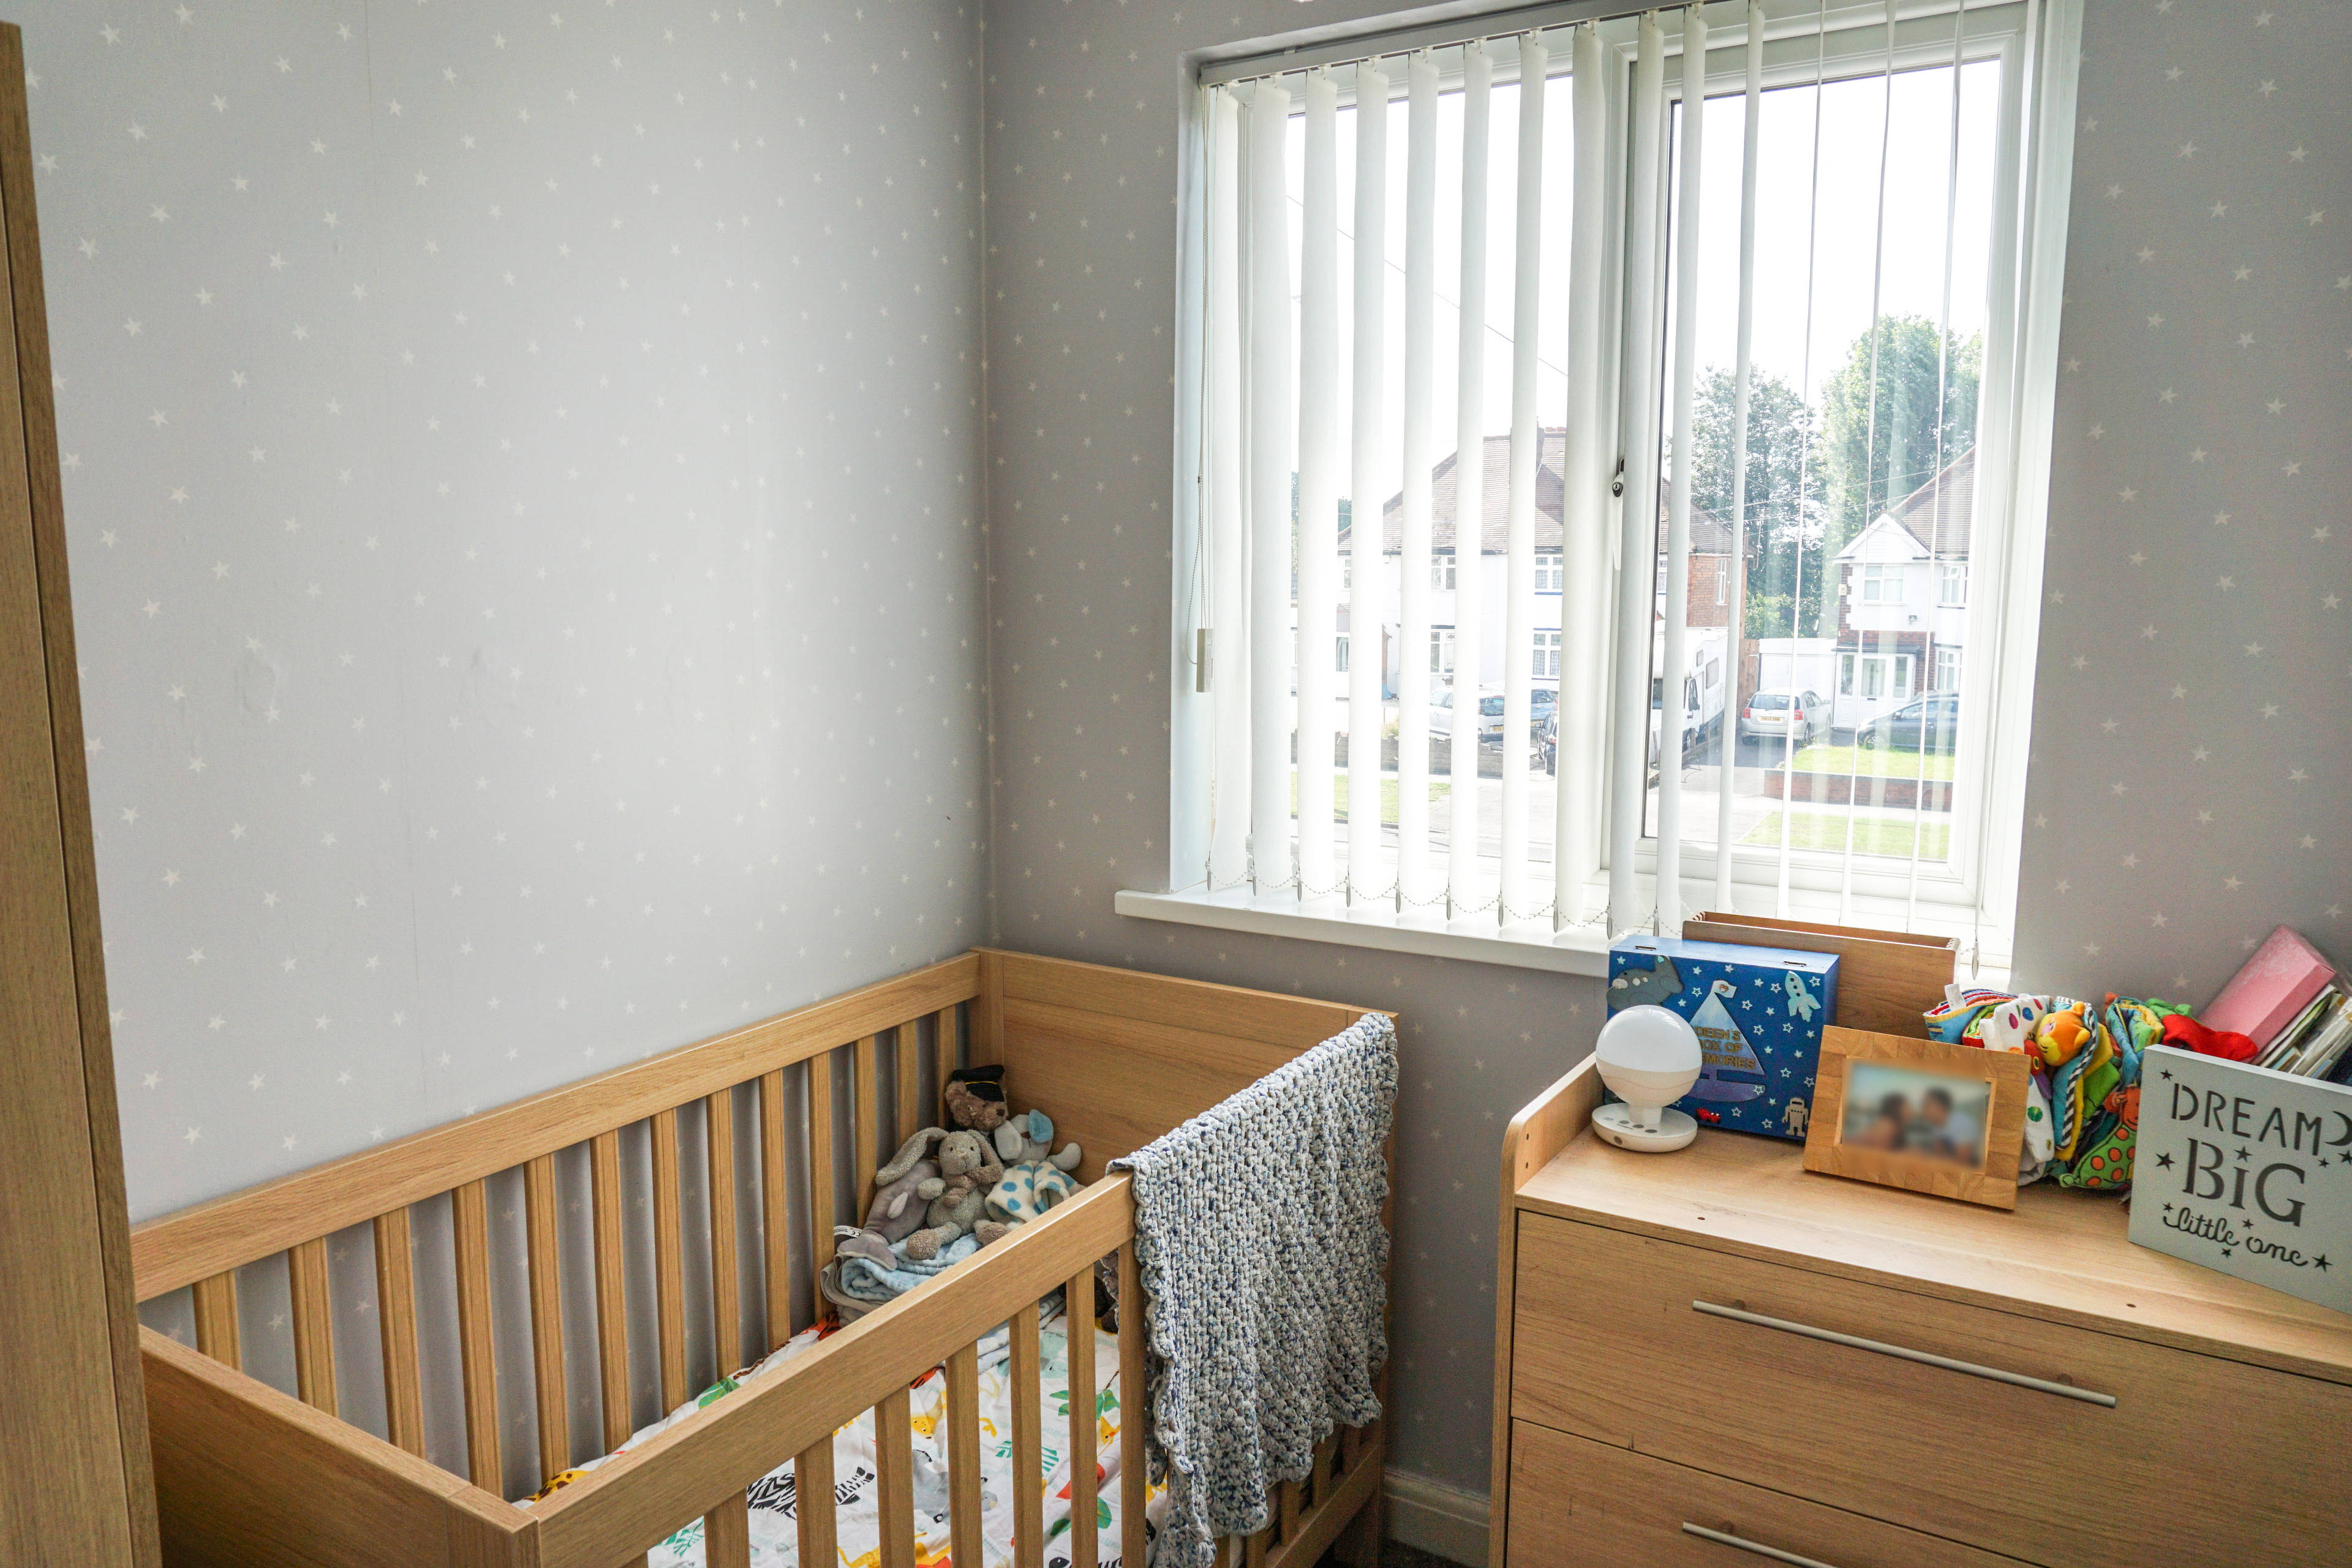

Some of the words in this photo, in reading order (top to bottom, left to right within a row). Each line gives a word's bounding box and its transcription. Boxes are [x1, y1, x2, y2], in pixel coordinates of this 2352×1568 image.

[1692, 1025, 1741, 1041] DEEN'S
[1724, 1042, 1743, 1052] OF
[1702, 1052, 1755, 1069] EMORIES
[2171, 1083, 2322, 1156] DREAM
[2182, 1137, 2305, 1227] BIG
[2163, 1207, 2240, 1246] little
[2246, 1237, 2308, 1266] one
